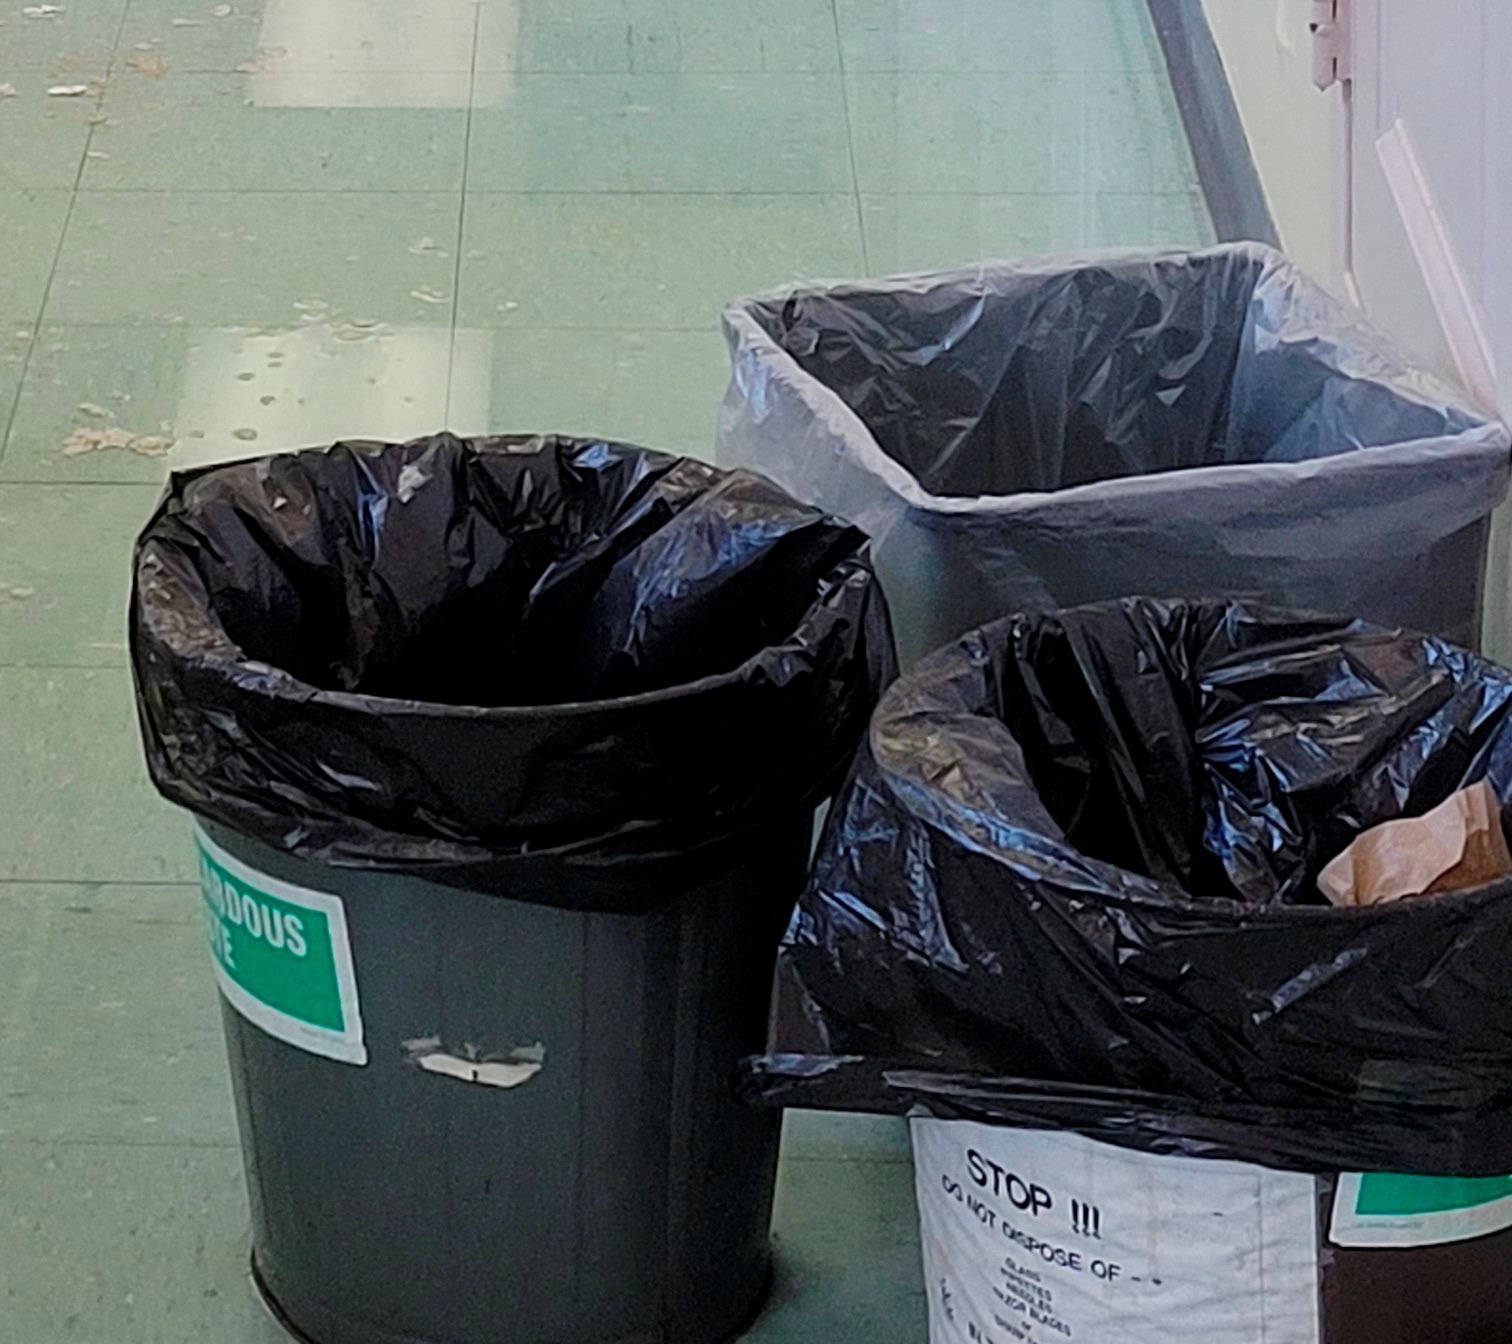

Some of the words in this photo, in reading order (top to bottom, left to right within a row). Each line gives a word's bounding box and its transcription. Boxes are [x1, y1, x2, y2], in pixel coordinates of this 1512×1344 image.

[941, 1174, 964, 1202] DO
[966, 1194, 997, 1228] NOT
[1002, 1221, 1083, 1272] DISPOSE
[1090, 1259, 1122, 1282] OF
[966, 1149, 1053, 1216] STOP
[1071, 1199, 1102, 1240] !!!
